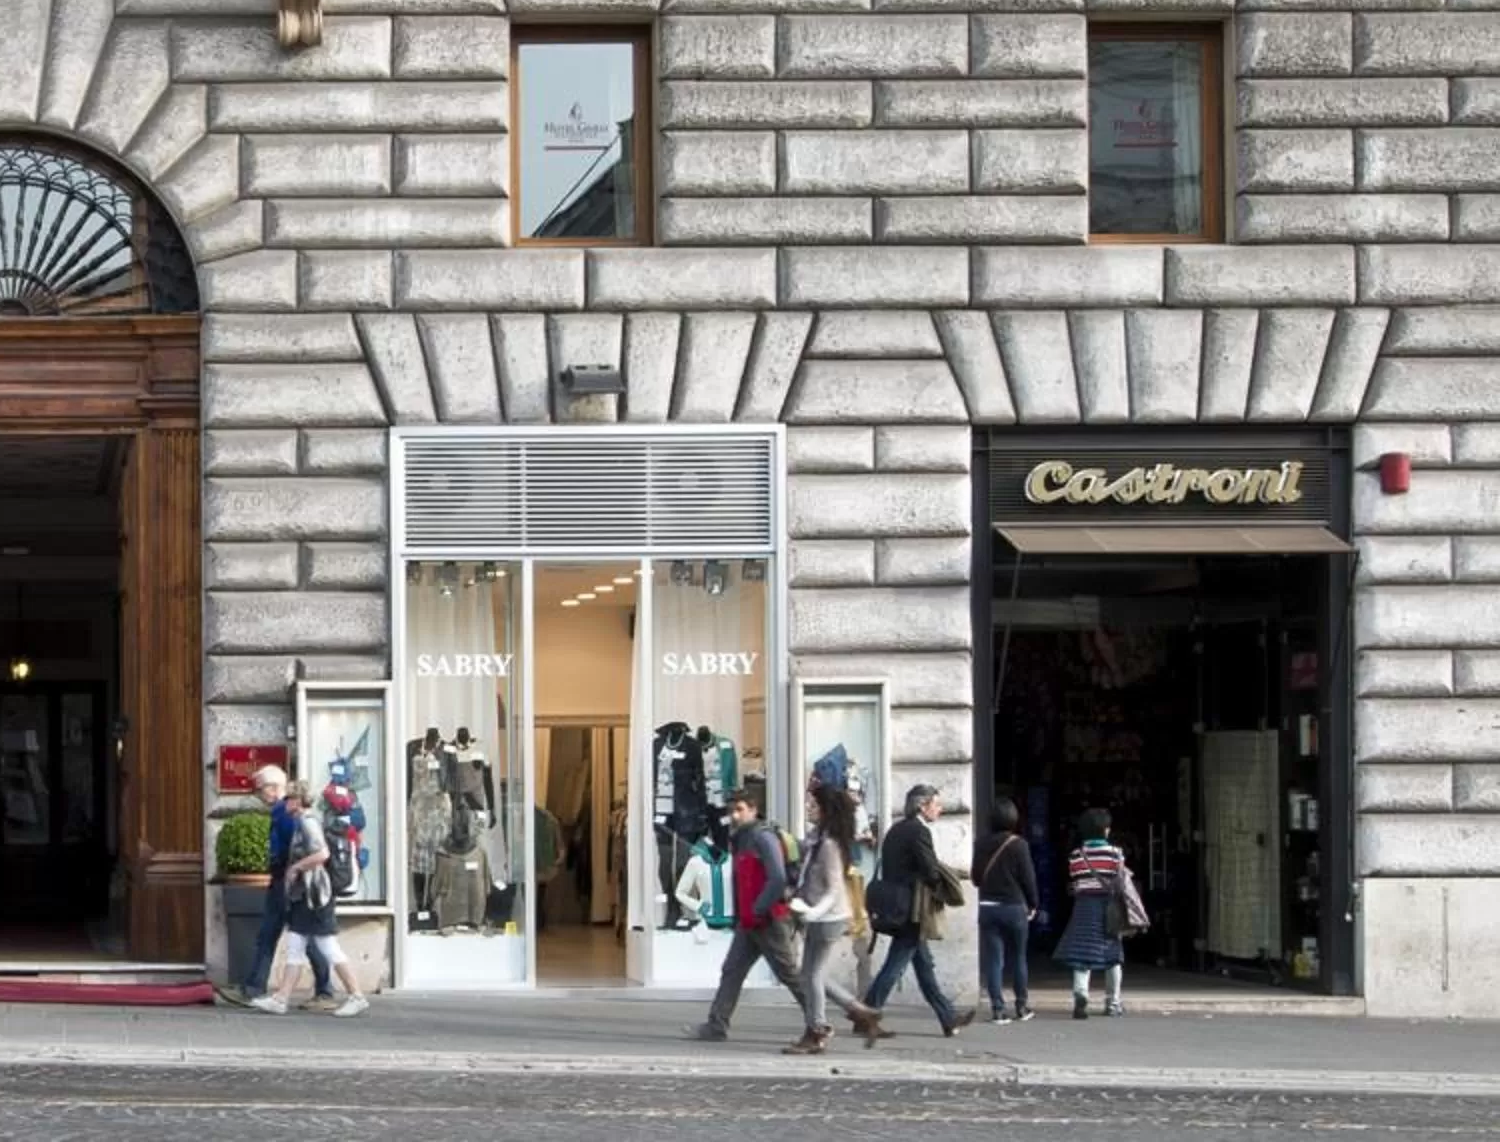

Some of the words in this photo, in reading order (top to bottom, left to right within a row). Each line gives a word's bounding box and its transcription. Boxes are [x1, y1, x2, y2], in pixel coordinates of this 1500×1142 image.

[1025, 460, 1303, 504] Castroni
[417, 654, 514, 676] SABRY
[662, 652, 760, 675] SABRY
